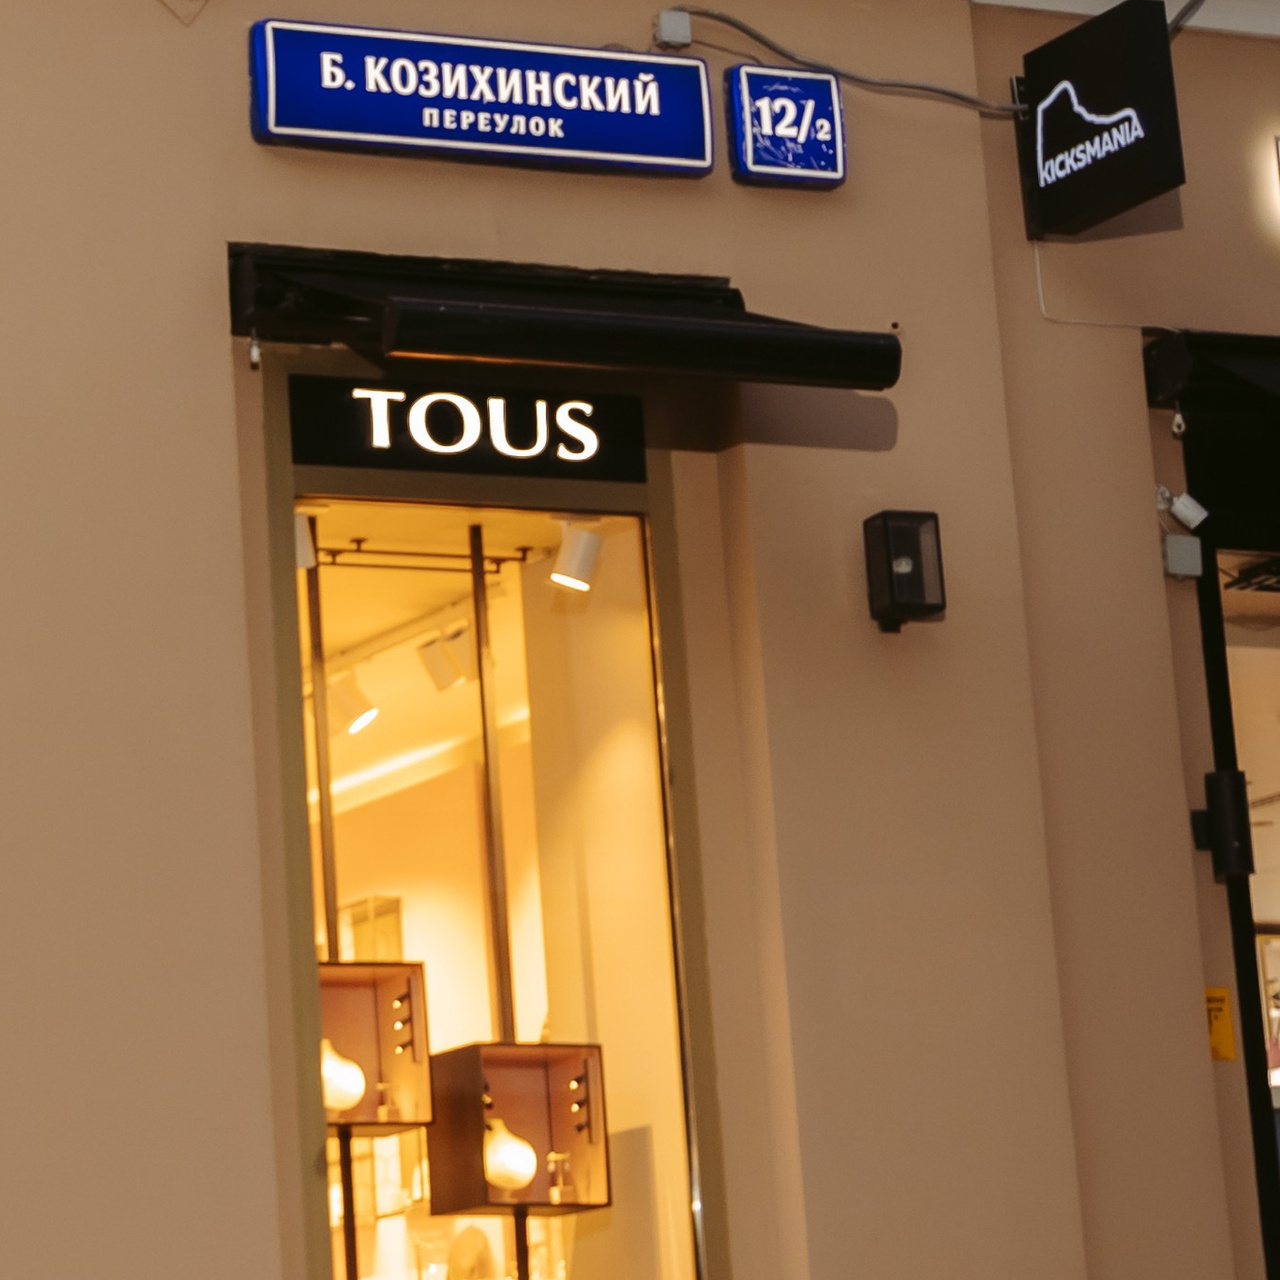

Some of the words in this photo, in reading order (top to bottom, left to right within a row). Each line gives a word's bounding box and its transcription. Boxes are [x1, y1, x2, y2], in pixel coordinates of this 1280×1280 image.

[320, 51, 356, 91] Б.
[364, 55, 661, 116] КОЗИХИНСКИЙ
[422, 107, 565, 138] ПЕРЕУЛОК
[755, 96, 832, 144] 12/2
[1038, 120, 1145, 187] KICKSMANIA
[352, 388, 599, 461] TOUS
